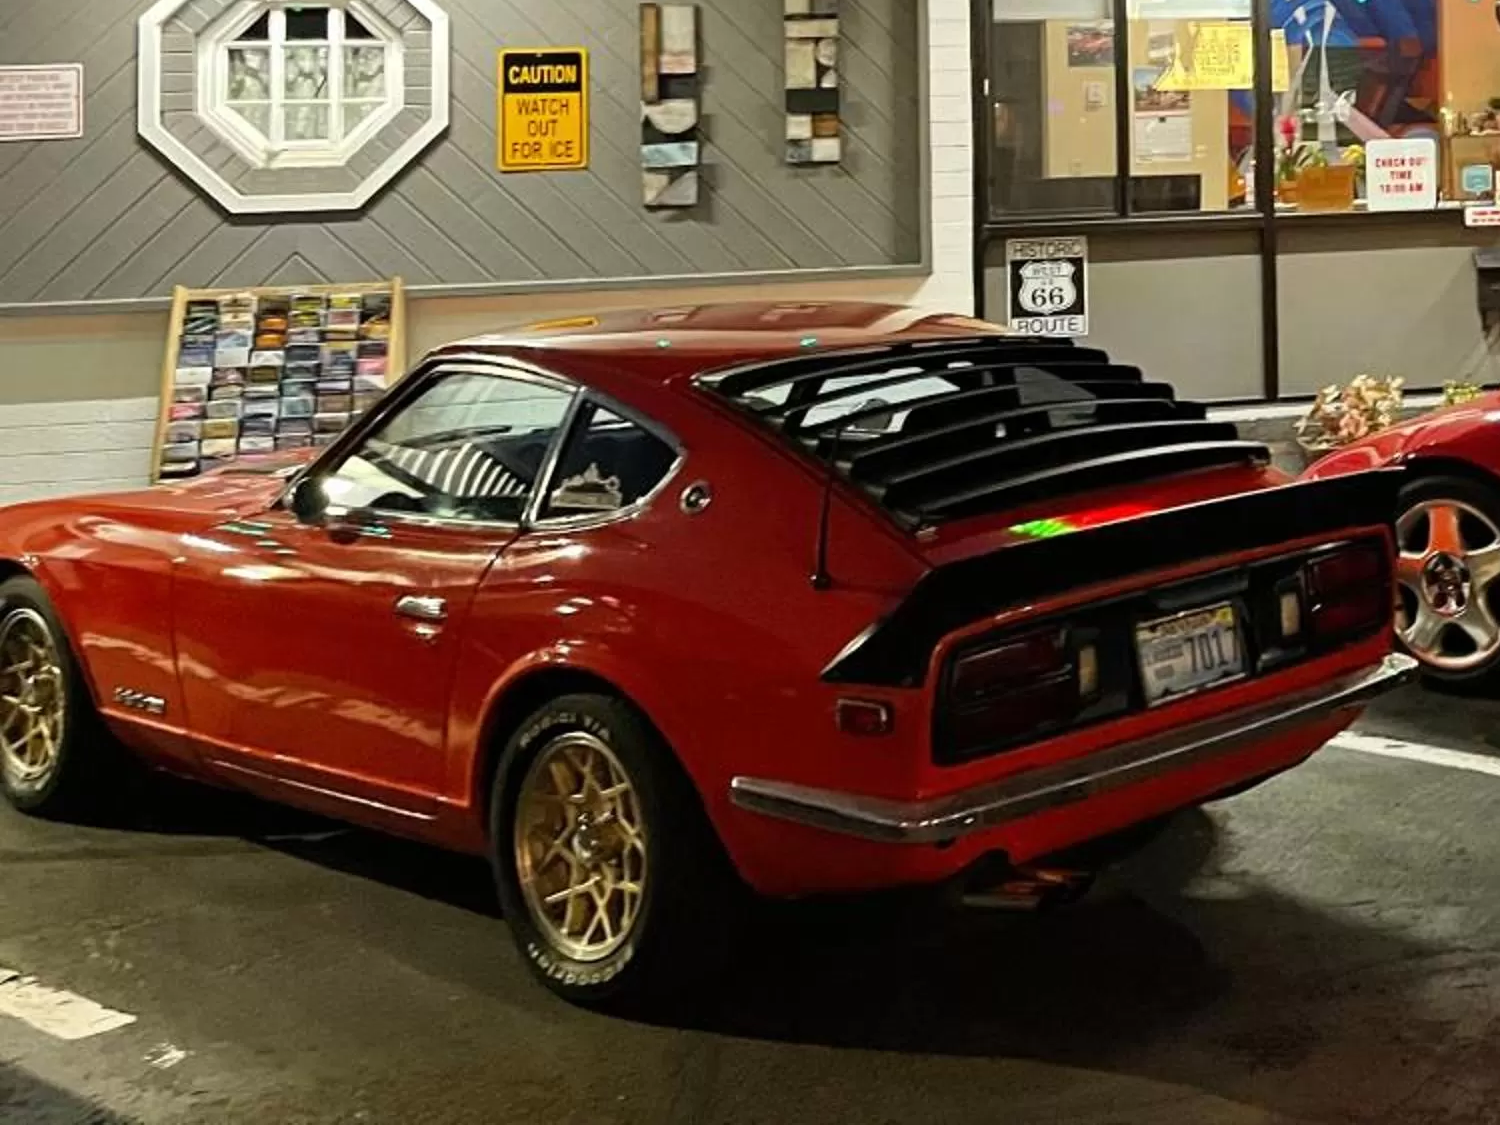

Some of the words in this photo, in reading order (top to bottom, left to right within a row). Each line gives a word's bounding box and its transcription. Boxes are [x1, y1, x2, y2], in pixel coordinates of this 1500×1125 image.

[508, 64, 577, 84] CAUTION
[516, 98, 570, 116] WATCH
[527, 119, 558, 137] OUT
[511, 142, 543, 159] FOR
[550, 140, 574, 158] ICE
[1375, 156, 1405, 168] CHECK
[1389, 169, 1412, 180] TIME
[1409, 181, 1424, 193] AM
[1013, 241, 1081, 257] HISTORIC
[1031, 286, 1064, 308] 66
[1017, 317, 1078, 334] ROUTE
